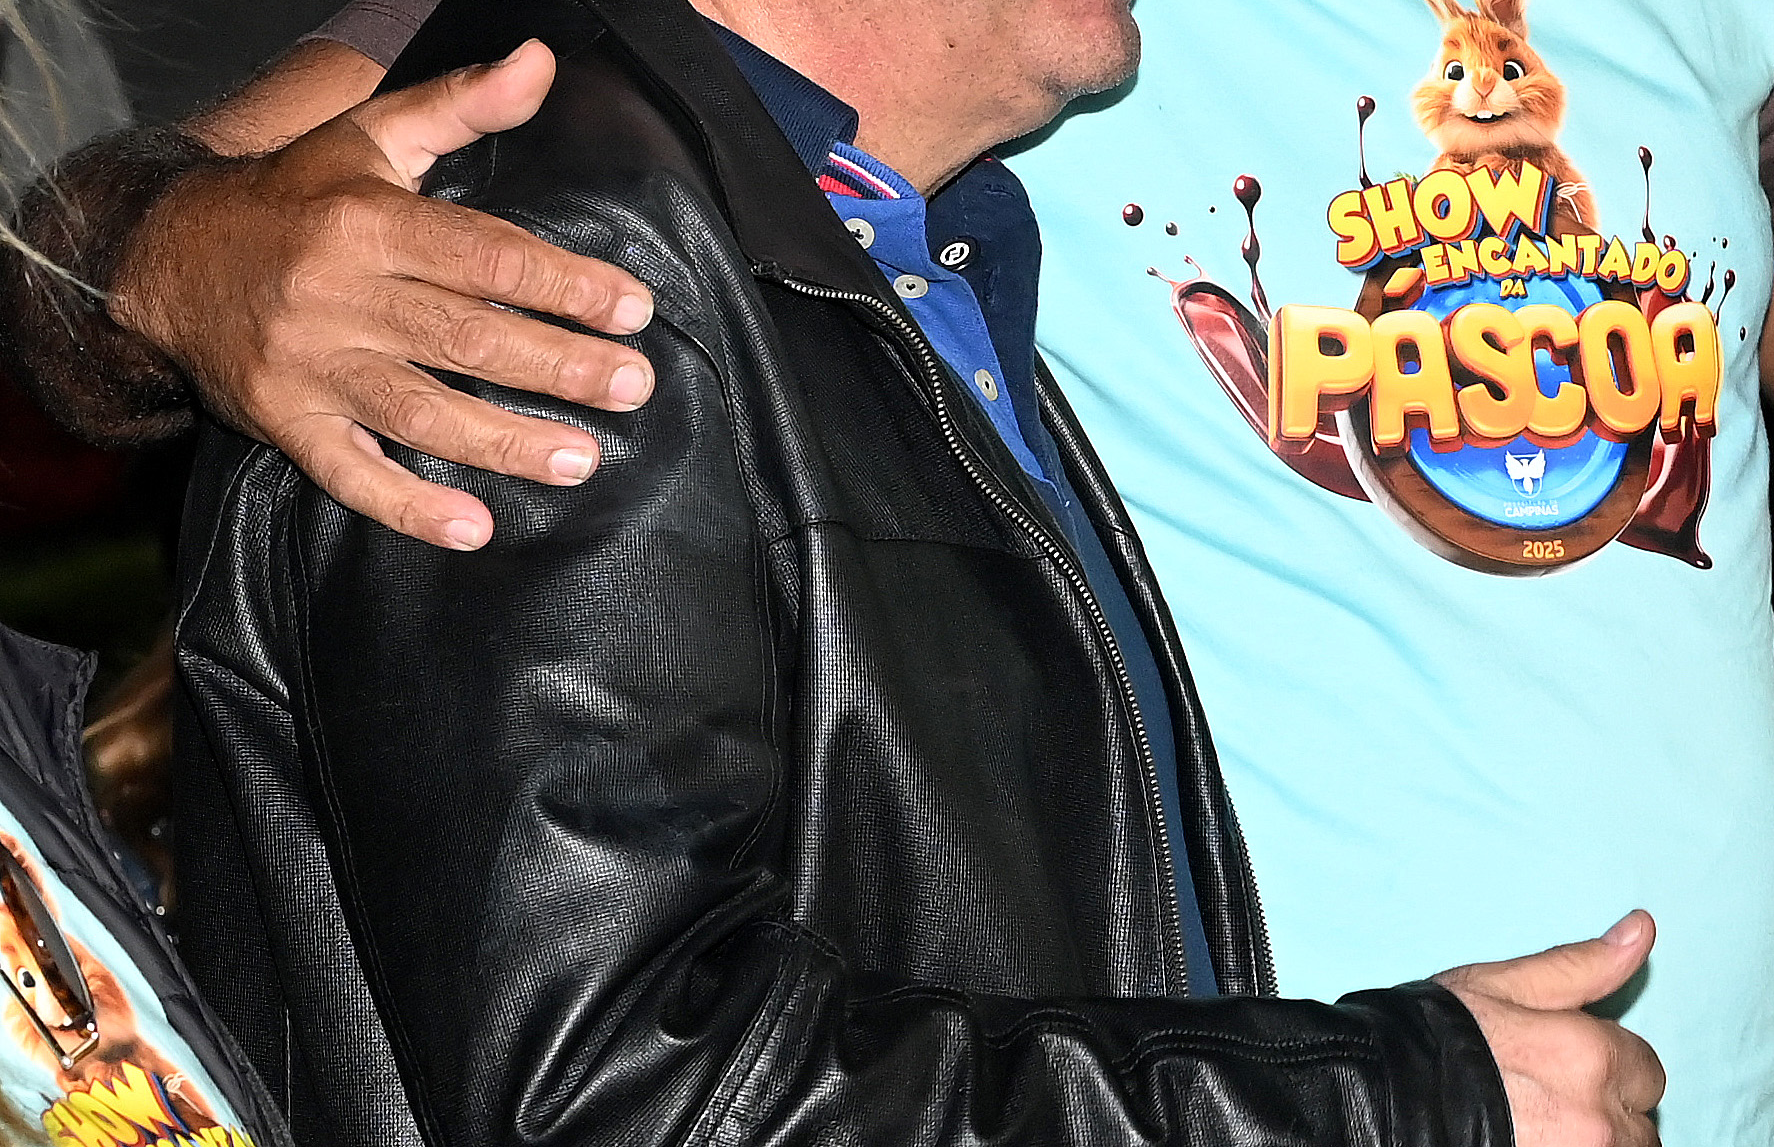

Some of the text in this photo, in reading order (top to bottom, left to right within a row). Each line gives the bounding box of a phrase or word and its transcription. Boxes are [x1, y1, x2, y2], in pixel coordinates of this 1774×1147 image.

[1328, 159, 1553, 270] SHOW
[1420, 234, 1690, 296] ENCANTADO
[1500, 278, 1528, 297] DA
[1269, 266, 1720, 456] PÁSCOA
[1504, 504, 1559, 518] CAMPINAS
[1522, 539, 1566, 559] 2025
